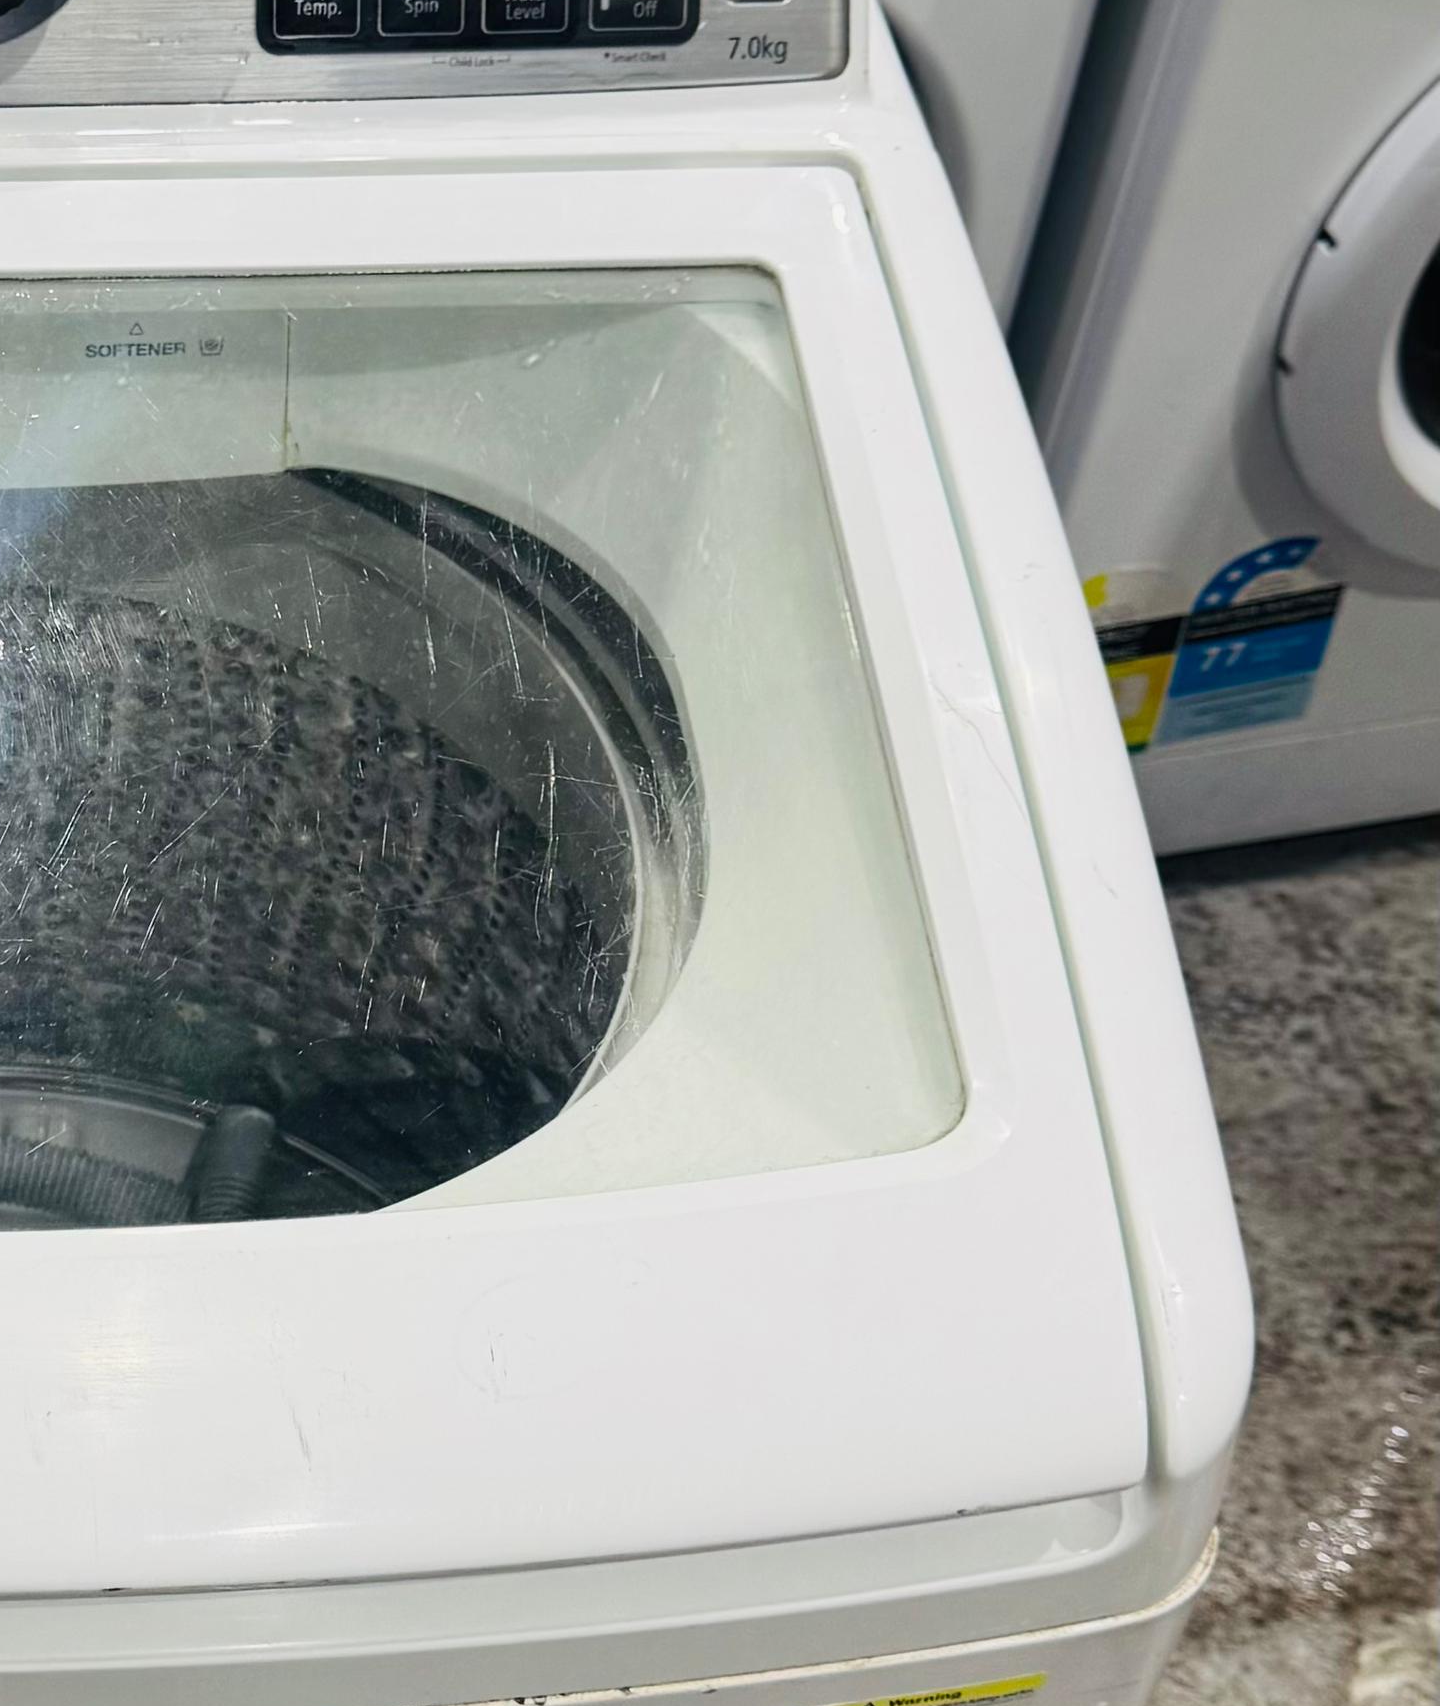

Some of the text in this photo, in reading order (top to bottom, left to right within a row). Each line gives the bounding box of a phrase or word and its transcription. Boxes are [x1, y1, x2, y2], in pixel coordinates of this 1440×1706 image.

[506, 0, 546, 20] Level
[633, 0, 659, 19] Off
[728, 36, 789, 64] 7.0kg
[86, 341, 186, 359] SOFTENER
